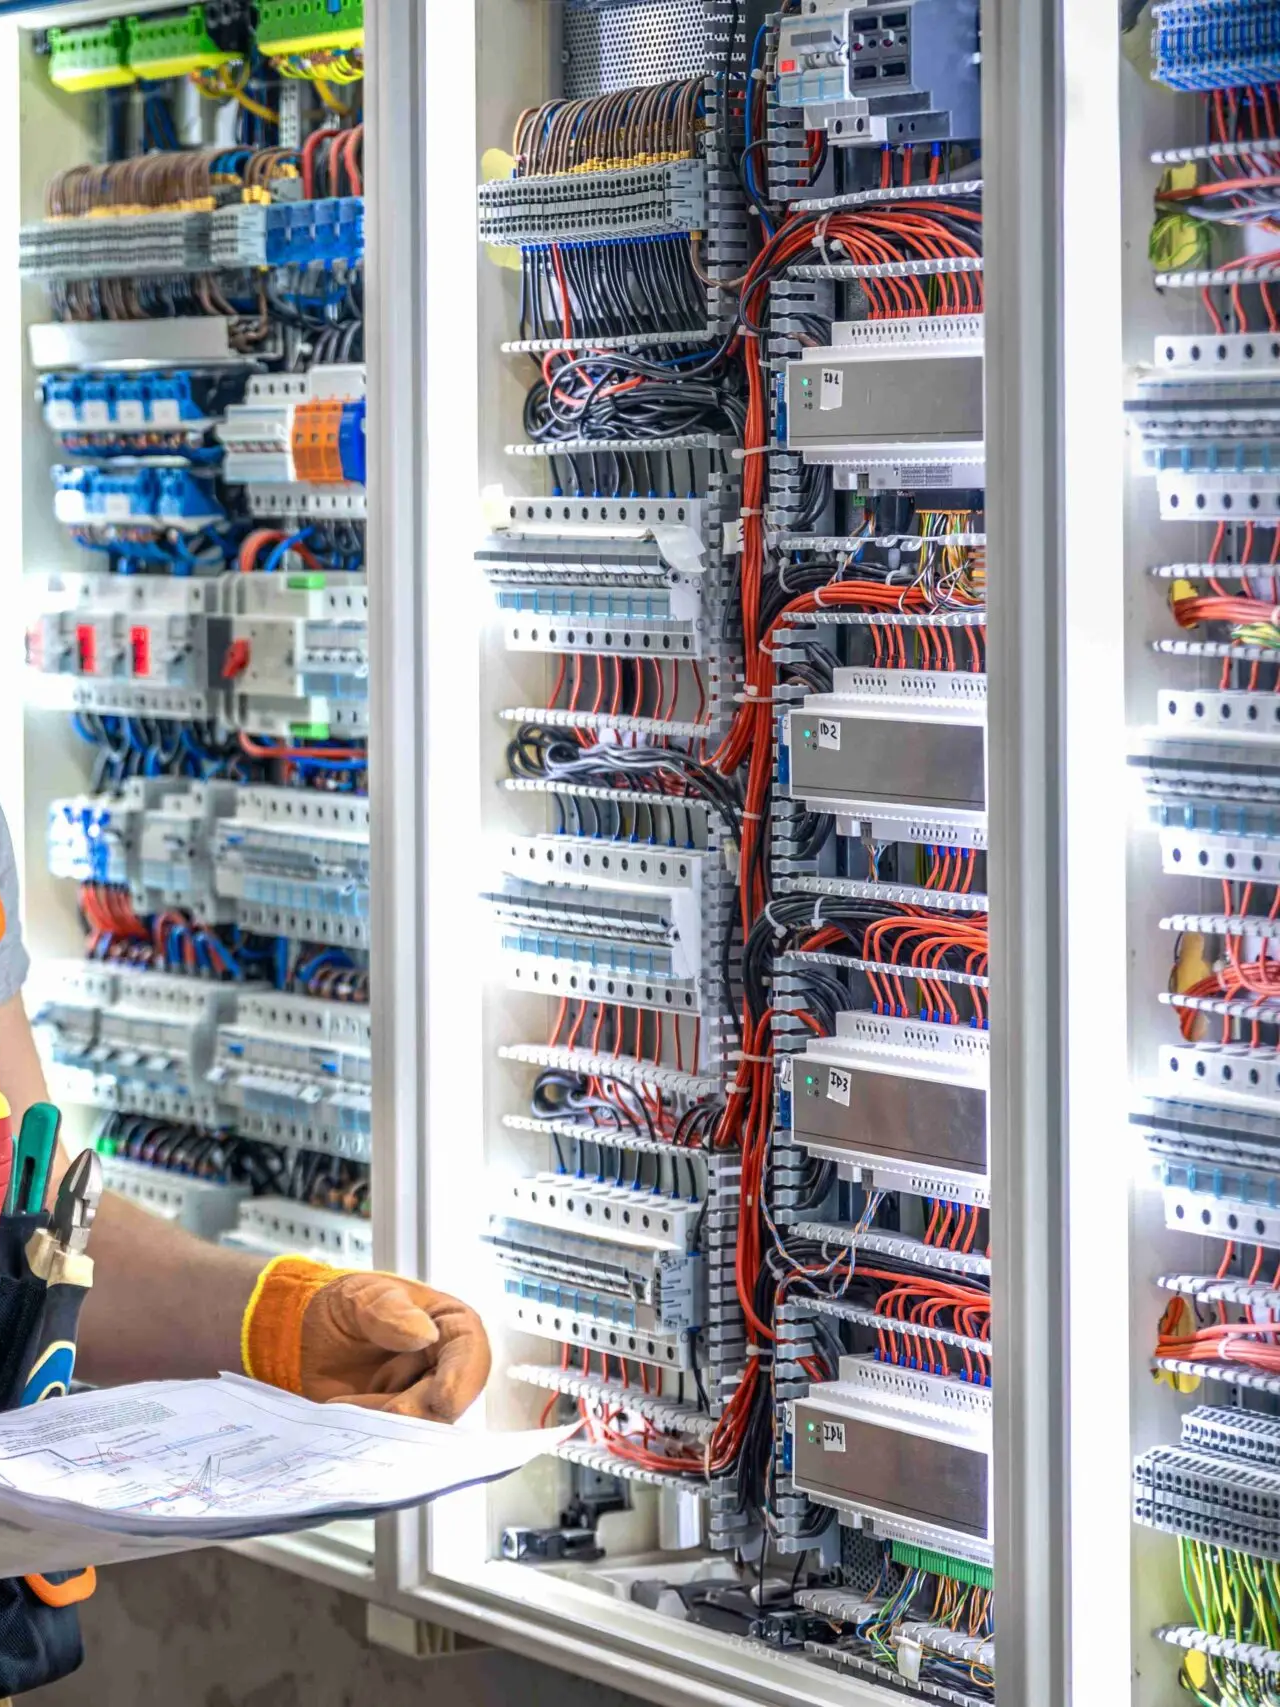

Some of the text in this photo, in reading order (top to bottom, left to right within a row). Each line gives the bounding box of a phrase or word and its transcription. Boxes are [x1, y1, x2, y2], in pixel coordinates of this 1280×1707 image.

[820, 722, 838, 740] ID2
[830, 1071, 848, 1092] ID3
[824, 1424, 843, 1445] ID4
